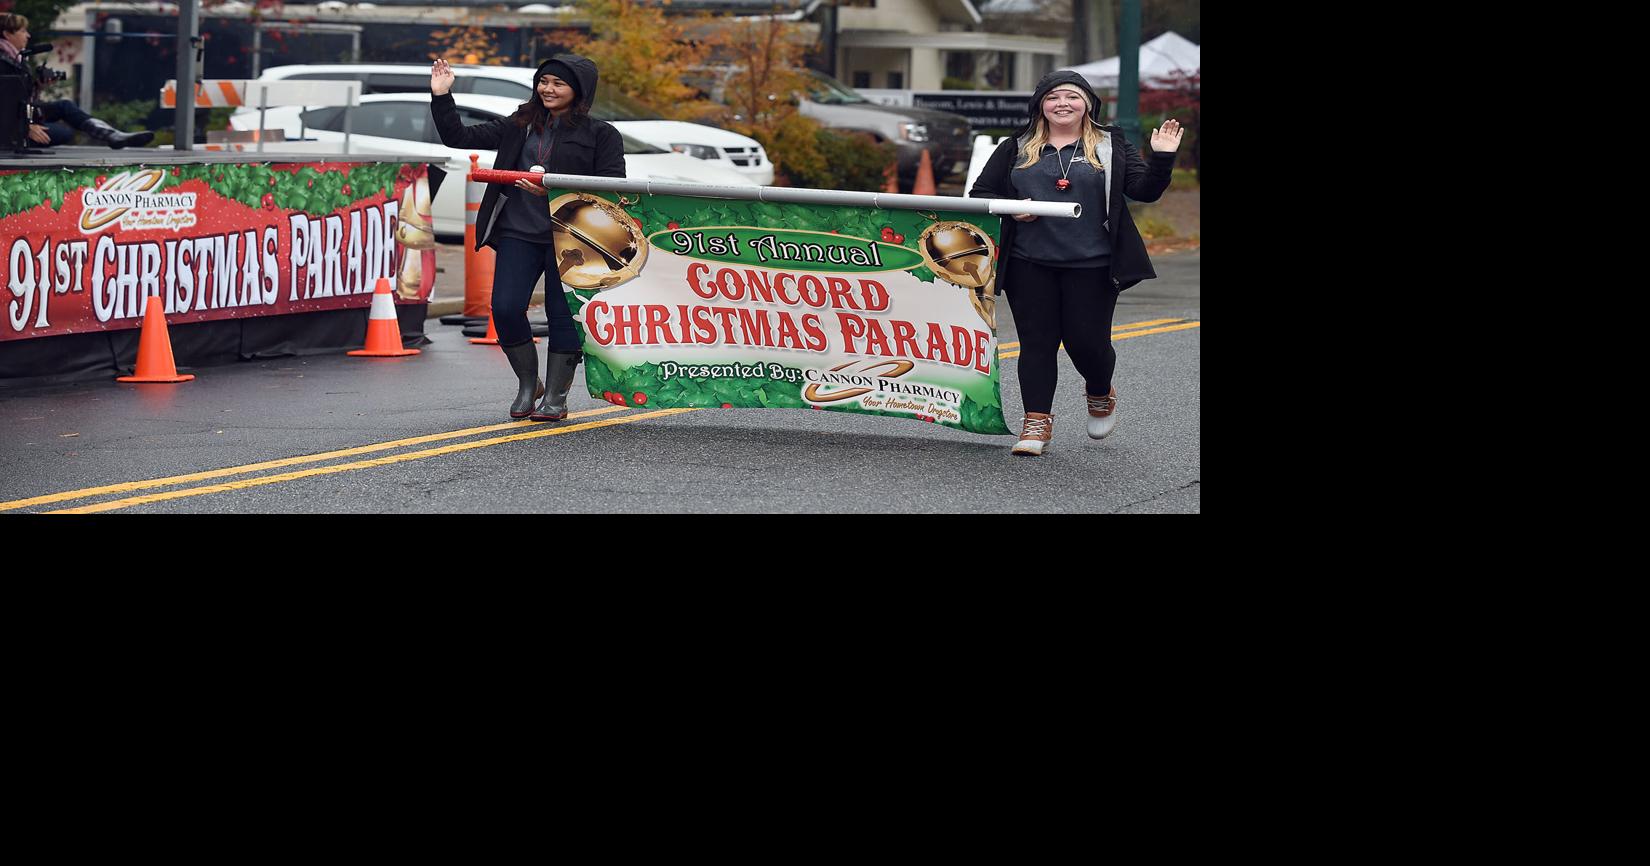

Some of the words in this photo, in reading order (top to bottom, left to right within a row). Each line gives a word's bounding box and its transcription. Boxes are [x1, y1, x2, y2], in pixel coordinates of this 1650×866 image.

[84, 191, 131, 206] CANNON
[135, 194, 194, 209] PHARMACY
[8, 238, 88, 332] 91ST
[91, 226, 279, 323] CHRISTMAS
[288, 200, 398, 302] PARADE
[671, 230, 741, 256] 91st
[749, 235, 883, 267] Annual
[686, 262, 891, 312] CONCORD
[585, 301, 830, 353] CHRISTMAS
[840, 312, 991, 375] PARADE
[661, 362, 765, 380] Presented
[768, 363, 802, 383] By:
[805, 369, 873, 386] CANNON
[878, 378, 961, 404] PHARMACY
[863, 396, 882, 407] Your
[885, 397, 925, 412] Hometown
[927, 403, 959, 421] Drugstore
